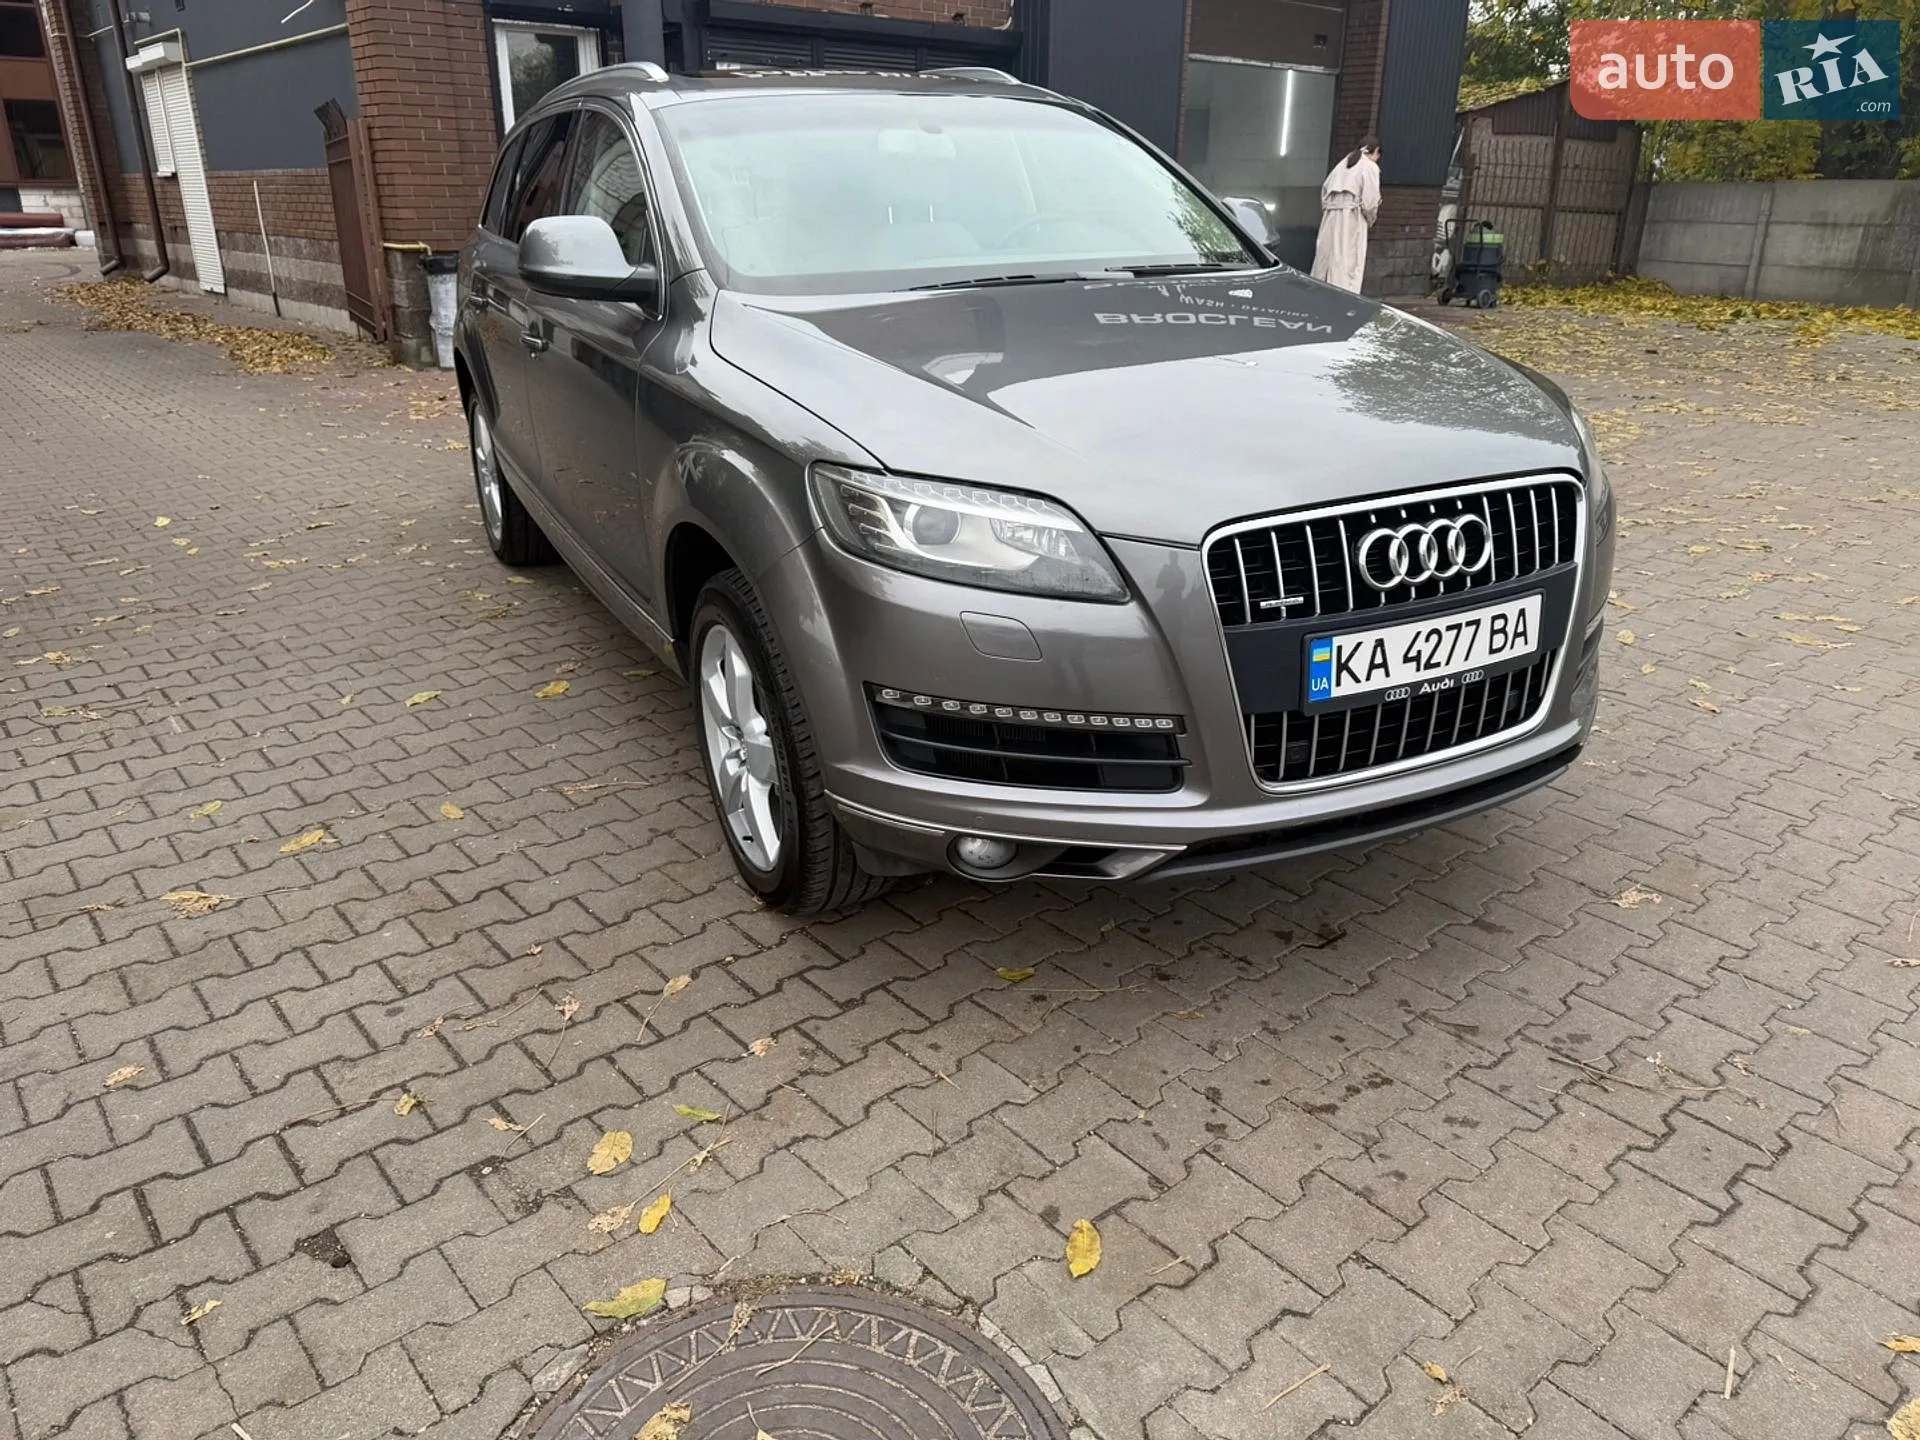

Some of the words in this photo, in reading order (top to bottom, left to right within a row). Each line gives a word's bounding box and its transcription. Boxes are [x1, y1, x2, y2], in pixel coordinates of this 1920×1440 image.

[1335, 637, 1391, 687] KA
[1402, 618, 1482, 673] 4277
[1488, 607, 1529, 655] BA
[1311, 675, 1329, 691] UA
[1419, 678, 1455, 695] Audi
